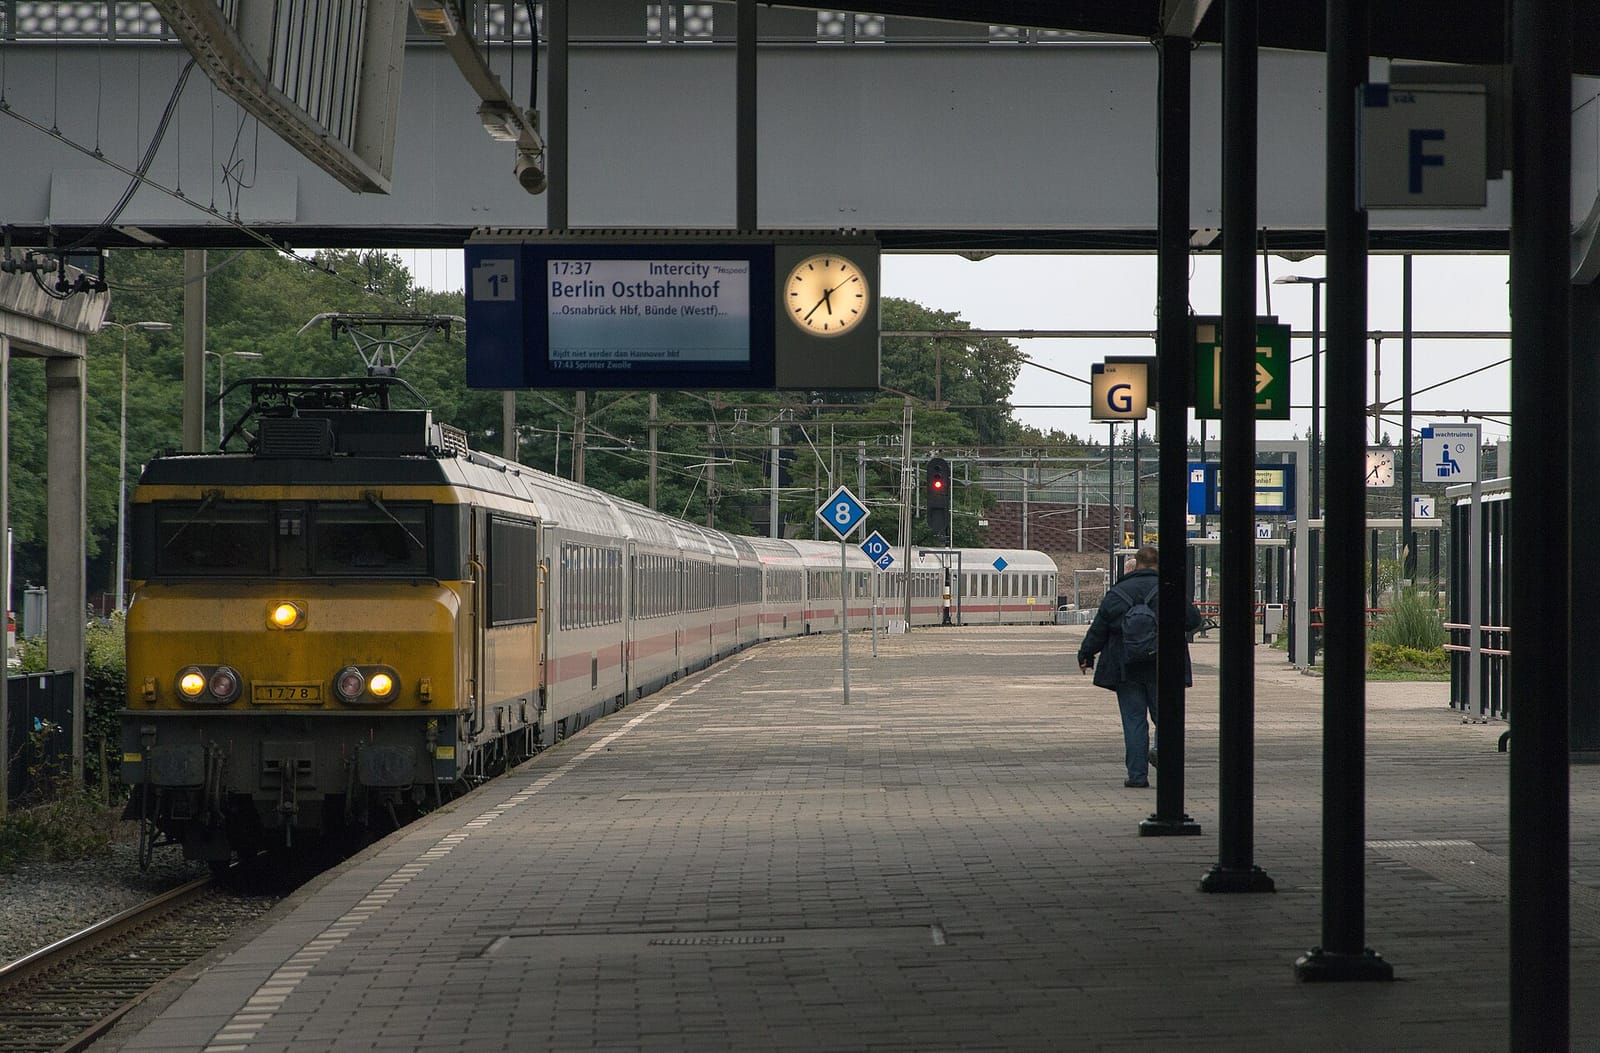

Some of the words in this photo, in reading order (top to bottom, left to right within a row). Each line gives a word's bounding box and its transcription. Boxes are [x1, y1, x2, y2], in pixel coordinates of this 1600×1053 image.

[1408, 129, 1445, 194] F
[552, 262, 592, 275] 17:37
[650, 262, 710, 279] Intercity
[551, 280, 605, 298] Berlin
[612, 280, 721, 298] Ostbahnhof
[620, 304, 641, 317] Hbf,
[644, 304, 678, 316] Bünde
[552, 350, 570, 359] Rijdt
[572, 350, 587, 358] niet
[588, 350, 612, 358] verder
[614, 350, 629, 358] dan
[630, 350, 666, 358] Hannover
[553, 361, 574, 369] 17:43
[575, 361, 605, 370] Sprinter
[606, 361, 632, 369] Zwolle
[1107, 384, 1132, 412] G
[835, 502, 851, 524] 8
[1420, 505, 1429, 516] K
[1259, 529, 1269, 537] M
[868, 542, 882, 554] 10
[269, 688, 308, 698] 1778
